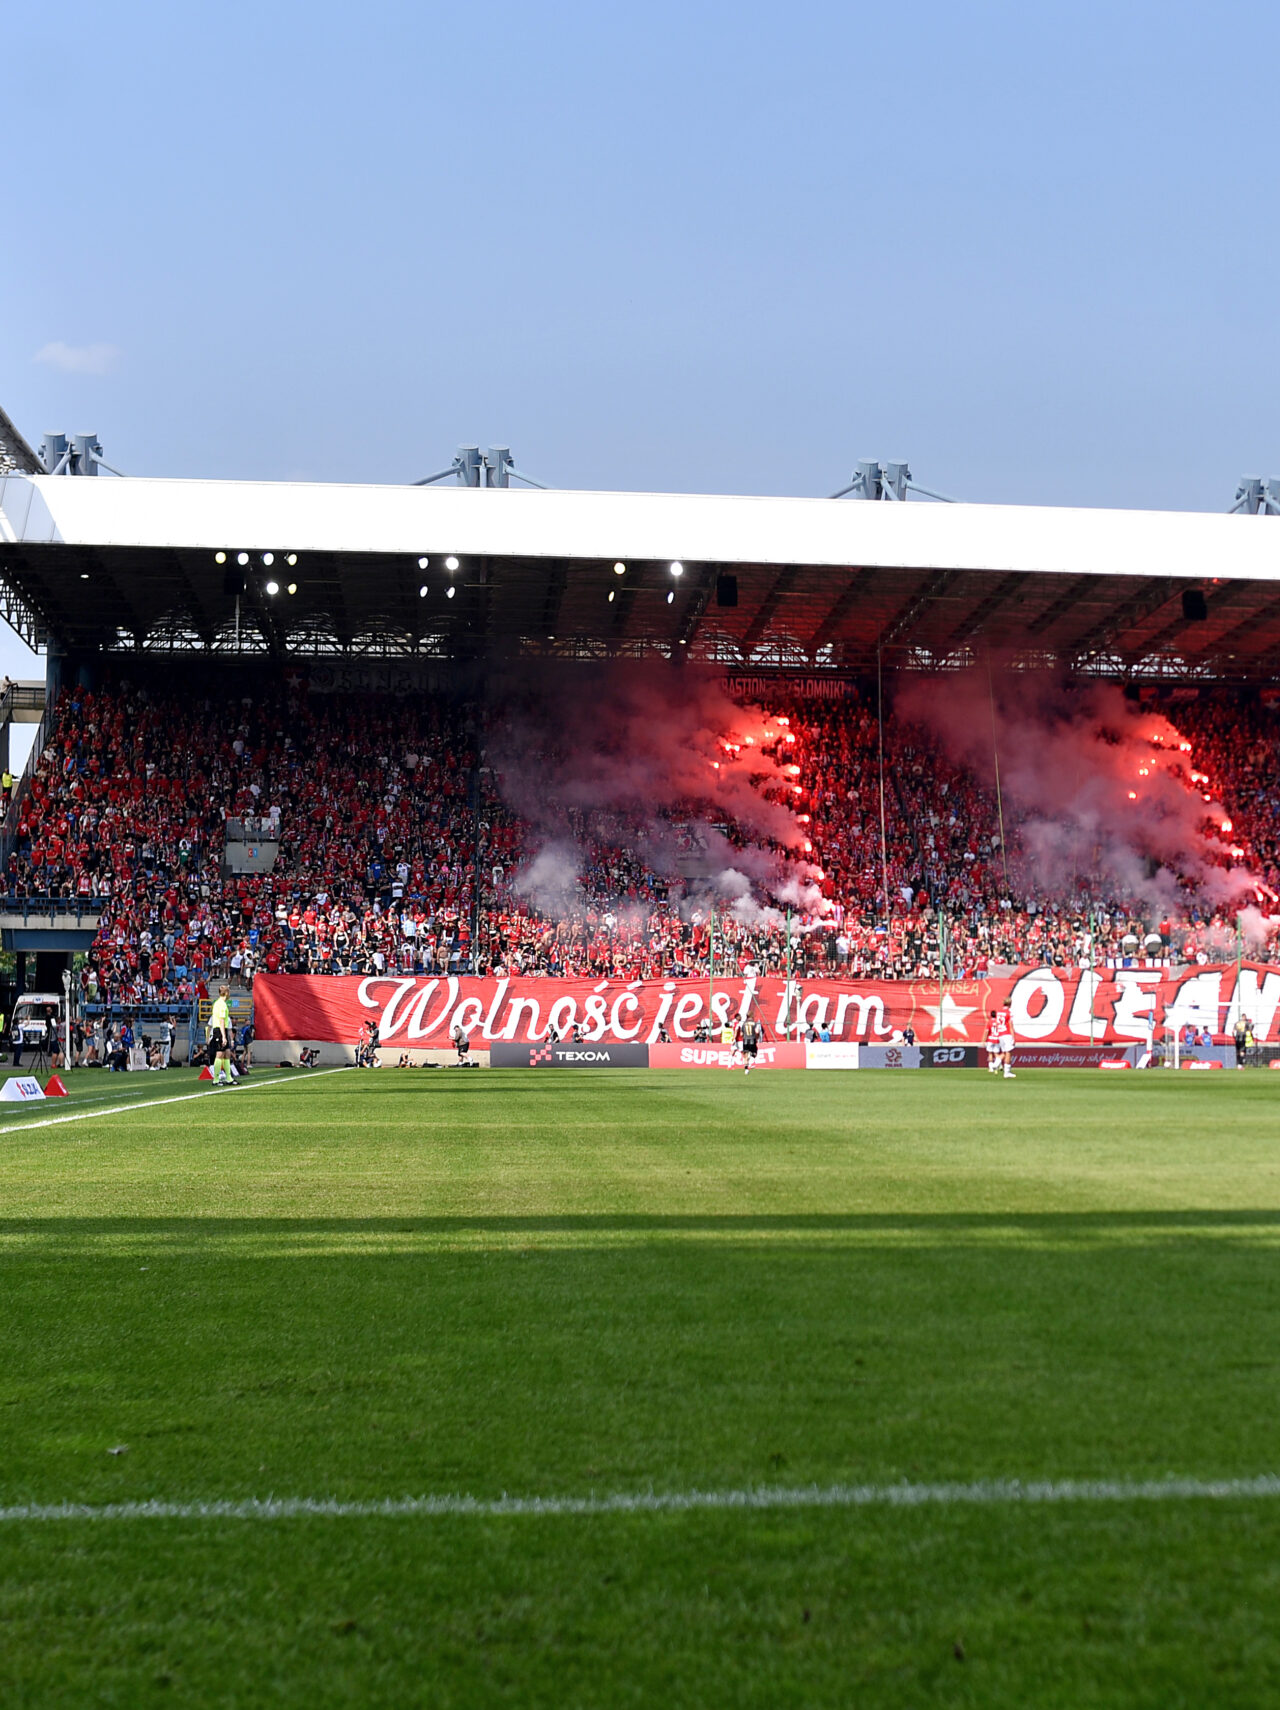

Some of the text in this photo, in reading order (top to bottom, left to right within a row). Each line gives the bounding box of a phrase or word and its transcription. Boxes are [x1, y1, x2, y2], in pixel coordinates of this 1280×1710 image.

[942, 981, 979, 996] WISŁA
[357, 976, 643, 1041] Wolność
[636, 978, 758, 1043] jest
[556, 1052, 611, 1061] TEXOM
[933, 1047, 966, 1063] GO
